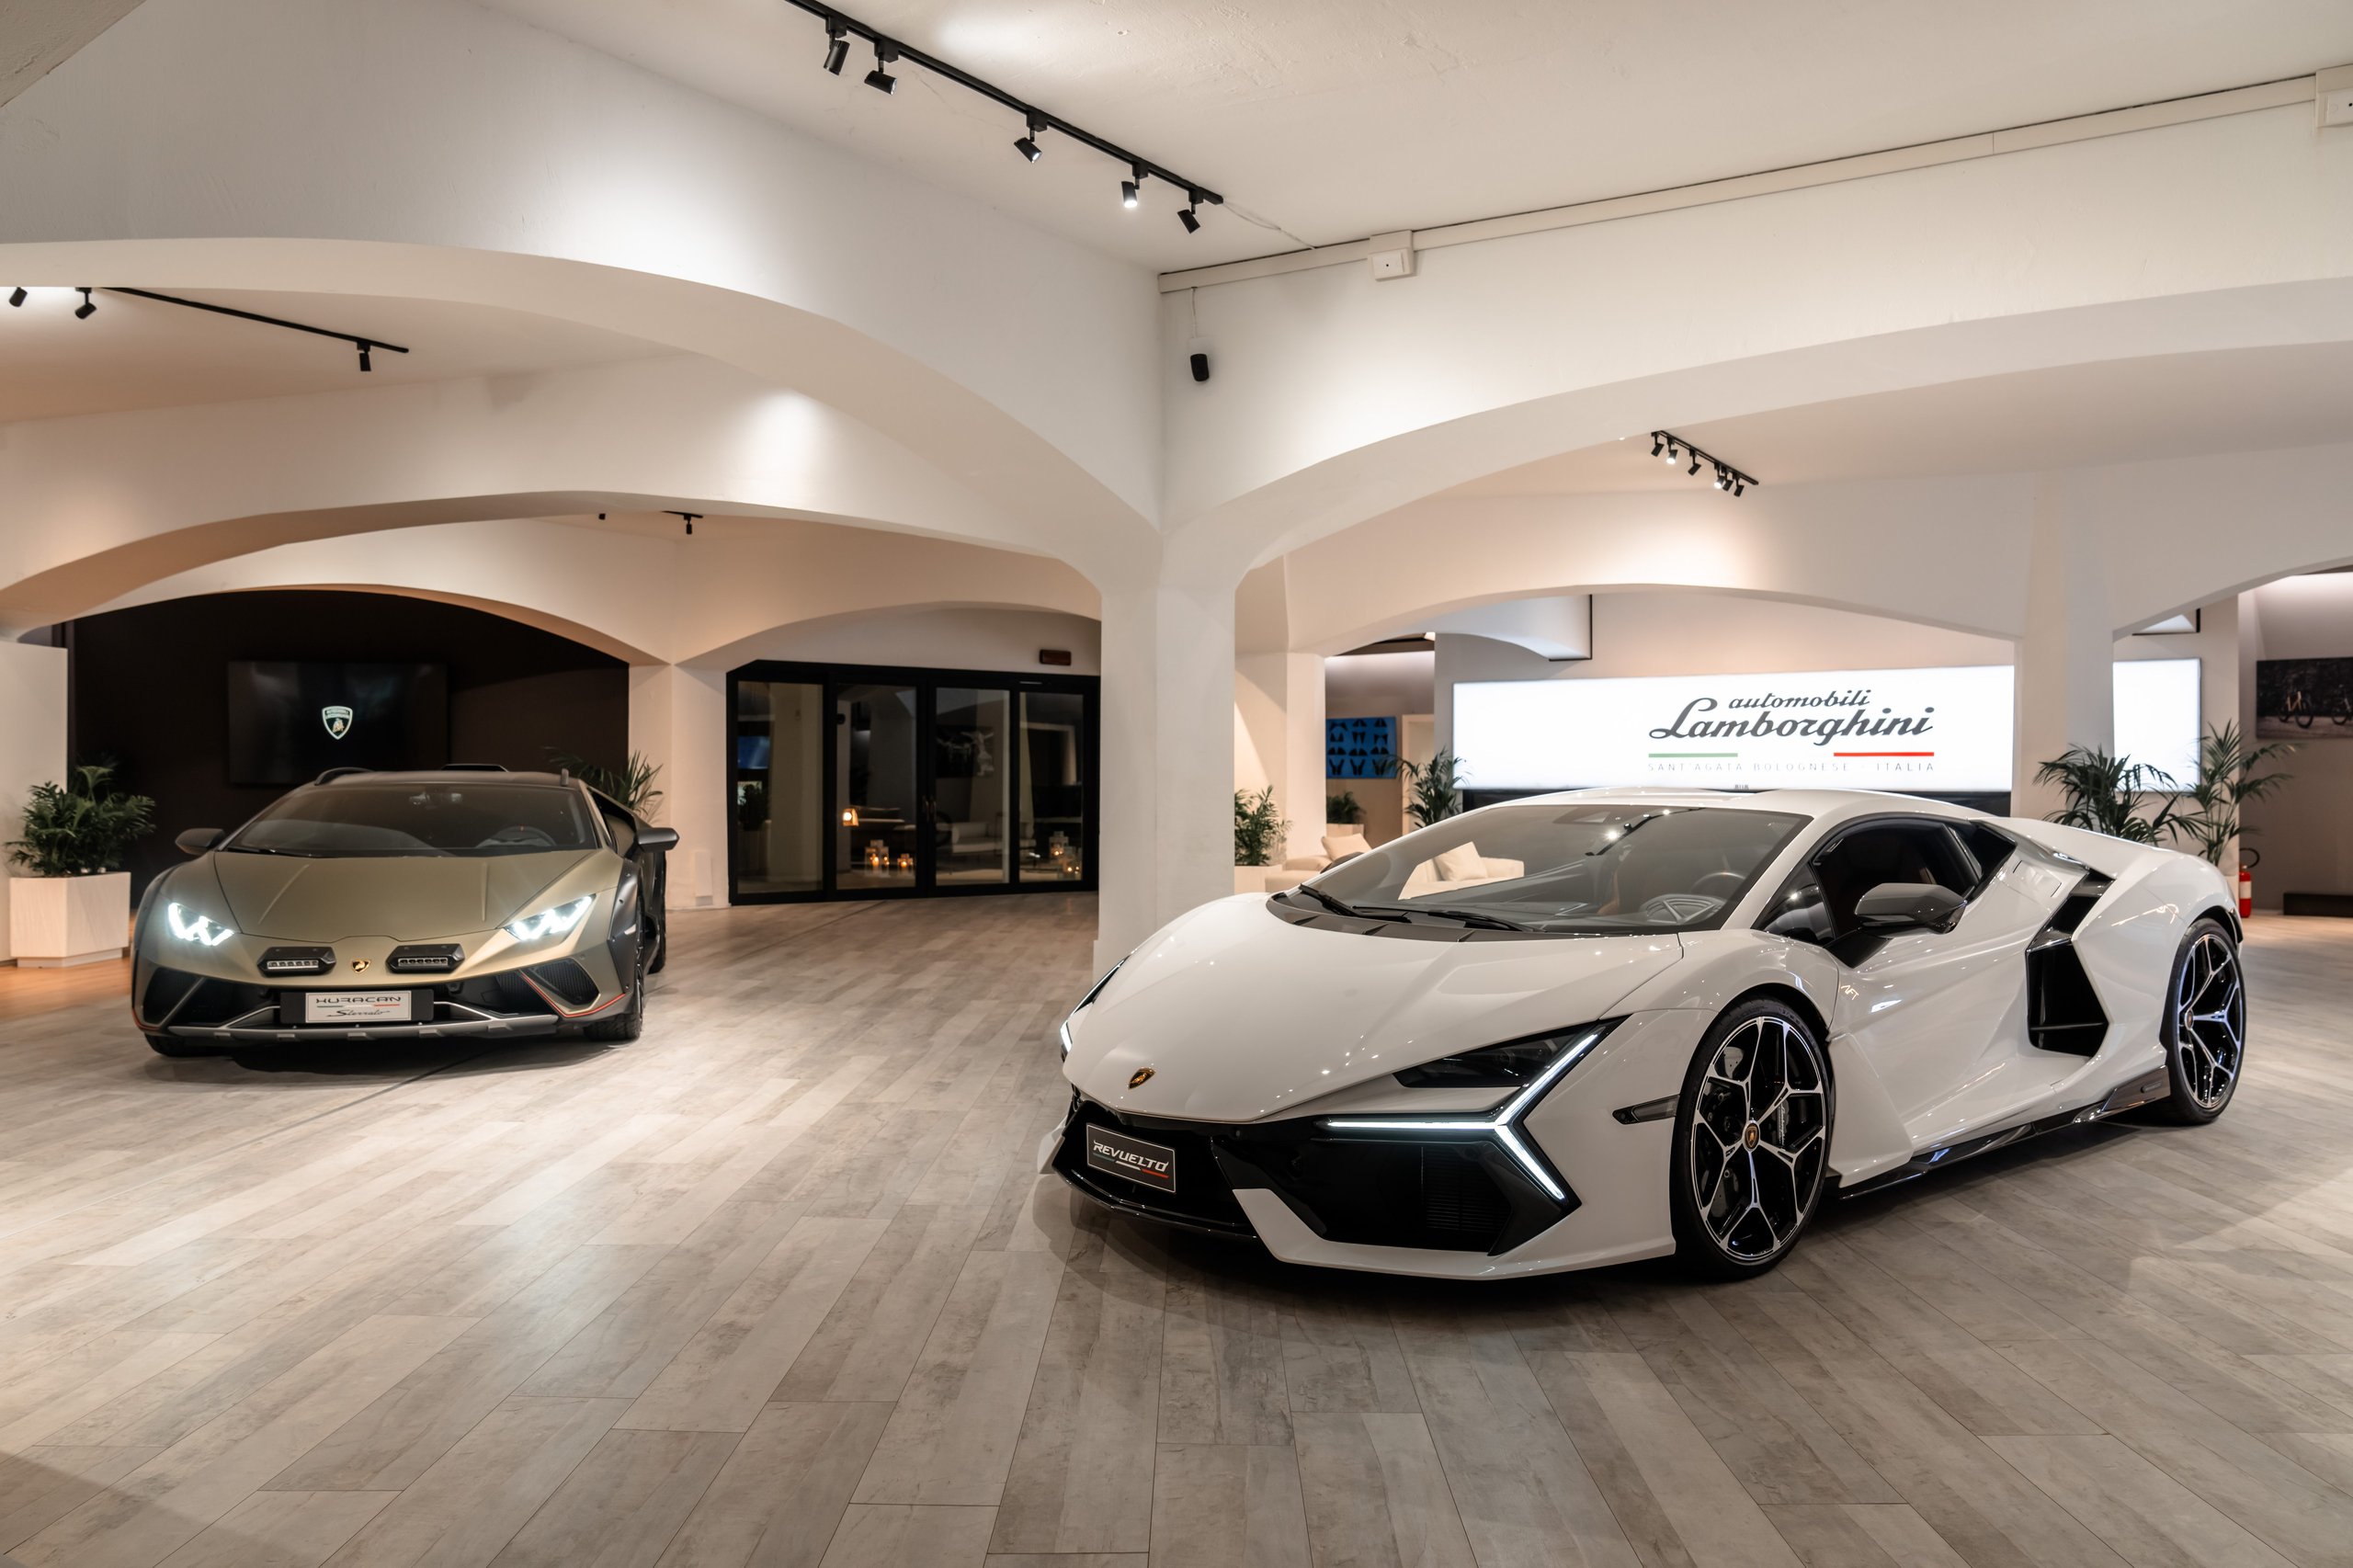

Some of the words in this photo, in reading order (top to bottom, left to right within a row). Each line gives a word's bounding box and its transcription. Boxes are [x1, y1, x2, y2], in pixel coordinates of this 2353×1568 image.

[1729, 689, 1871, 709] automobili
[1649, 698, 1935, 746] Lamborghini
[1648, 762, 1743, 772] SANT'AGATA
[1753, 762, 1850, 772] BOLOGNESE
[1877, 762, 1934, 772] ITALIA
[1093, 1140, 1169, 1172] REVUELTO
